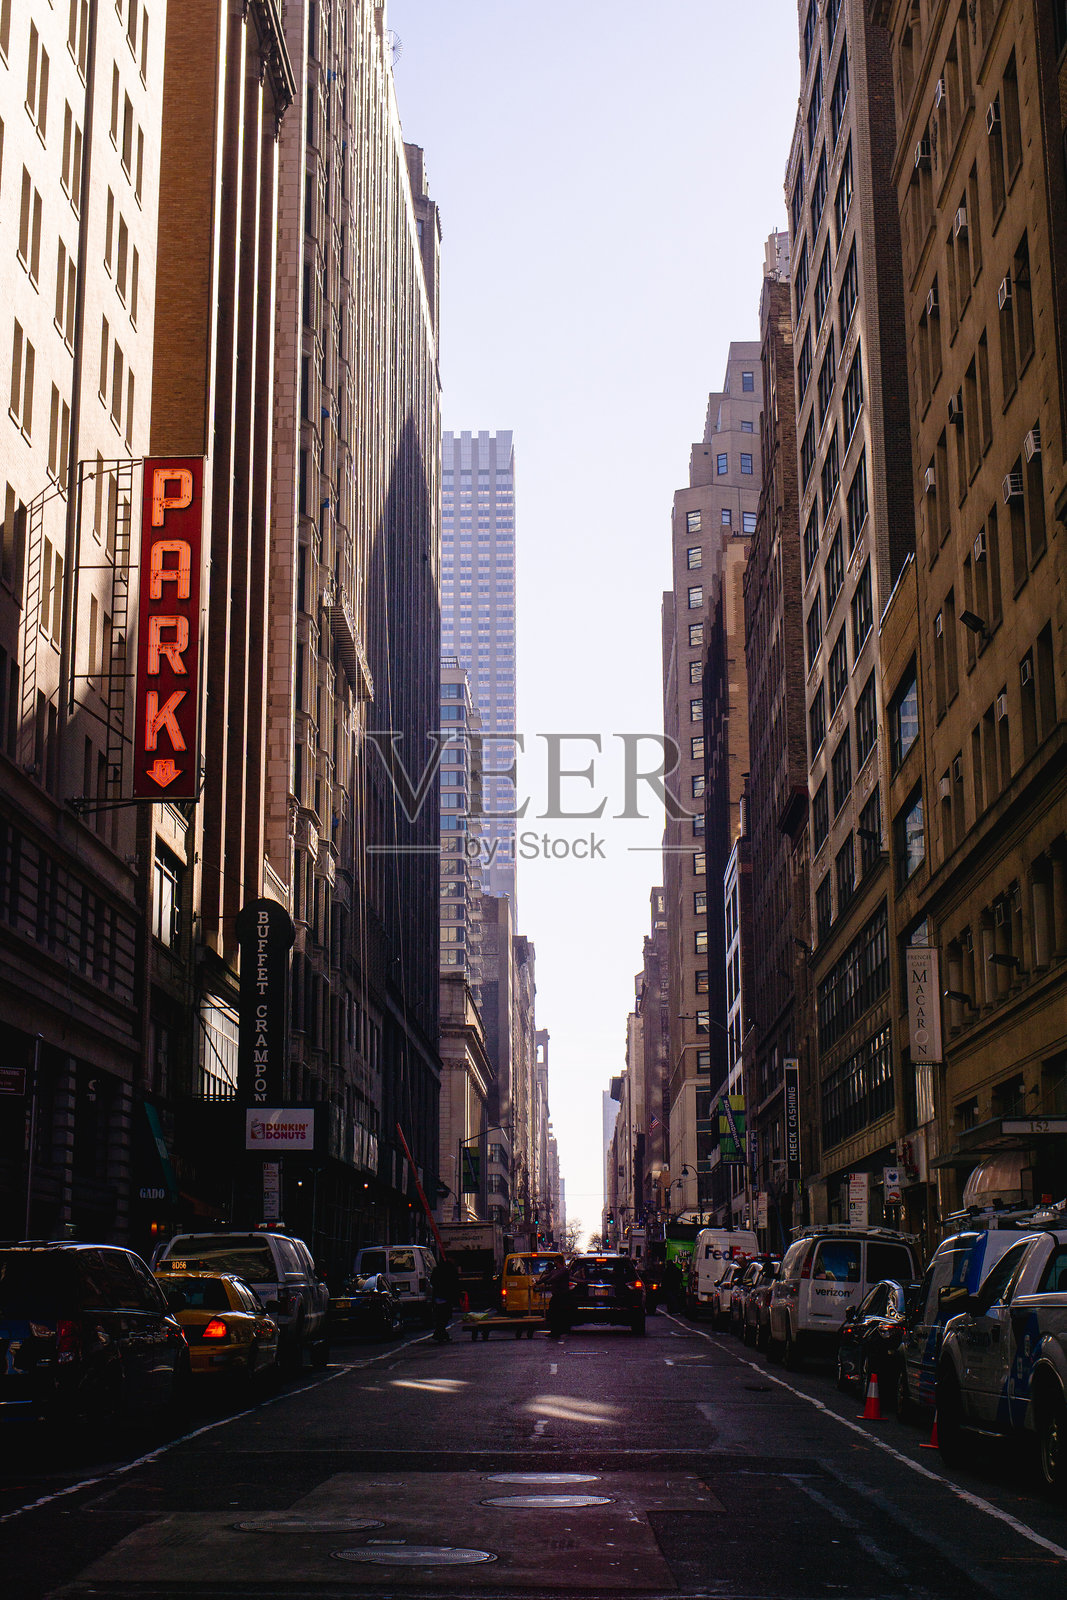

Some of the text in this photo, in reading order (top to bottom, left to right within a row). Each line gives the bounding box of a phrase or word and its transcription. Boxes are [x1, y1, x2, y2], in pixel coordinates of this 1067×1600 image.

[145, 468, 193, 750] PARK
[253, 911, 270, 1102] BUFFET CRAMPON
[912, 969, 929, 1055] MACARON
[266, 1123, 308, 1131] DUNKIN'
[788, 1086, 798, 1161] CHECK CASHING
[1030, 1121, 1049, 1132] 152
[266, 1131, 306, 1139] DONUTS
[139, 1187, 165, 1199] GADO
[705, 1245, 752, 1260] FedEx
[815, 1287, 850, 1297] verizon
